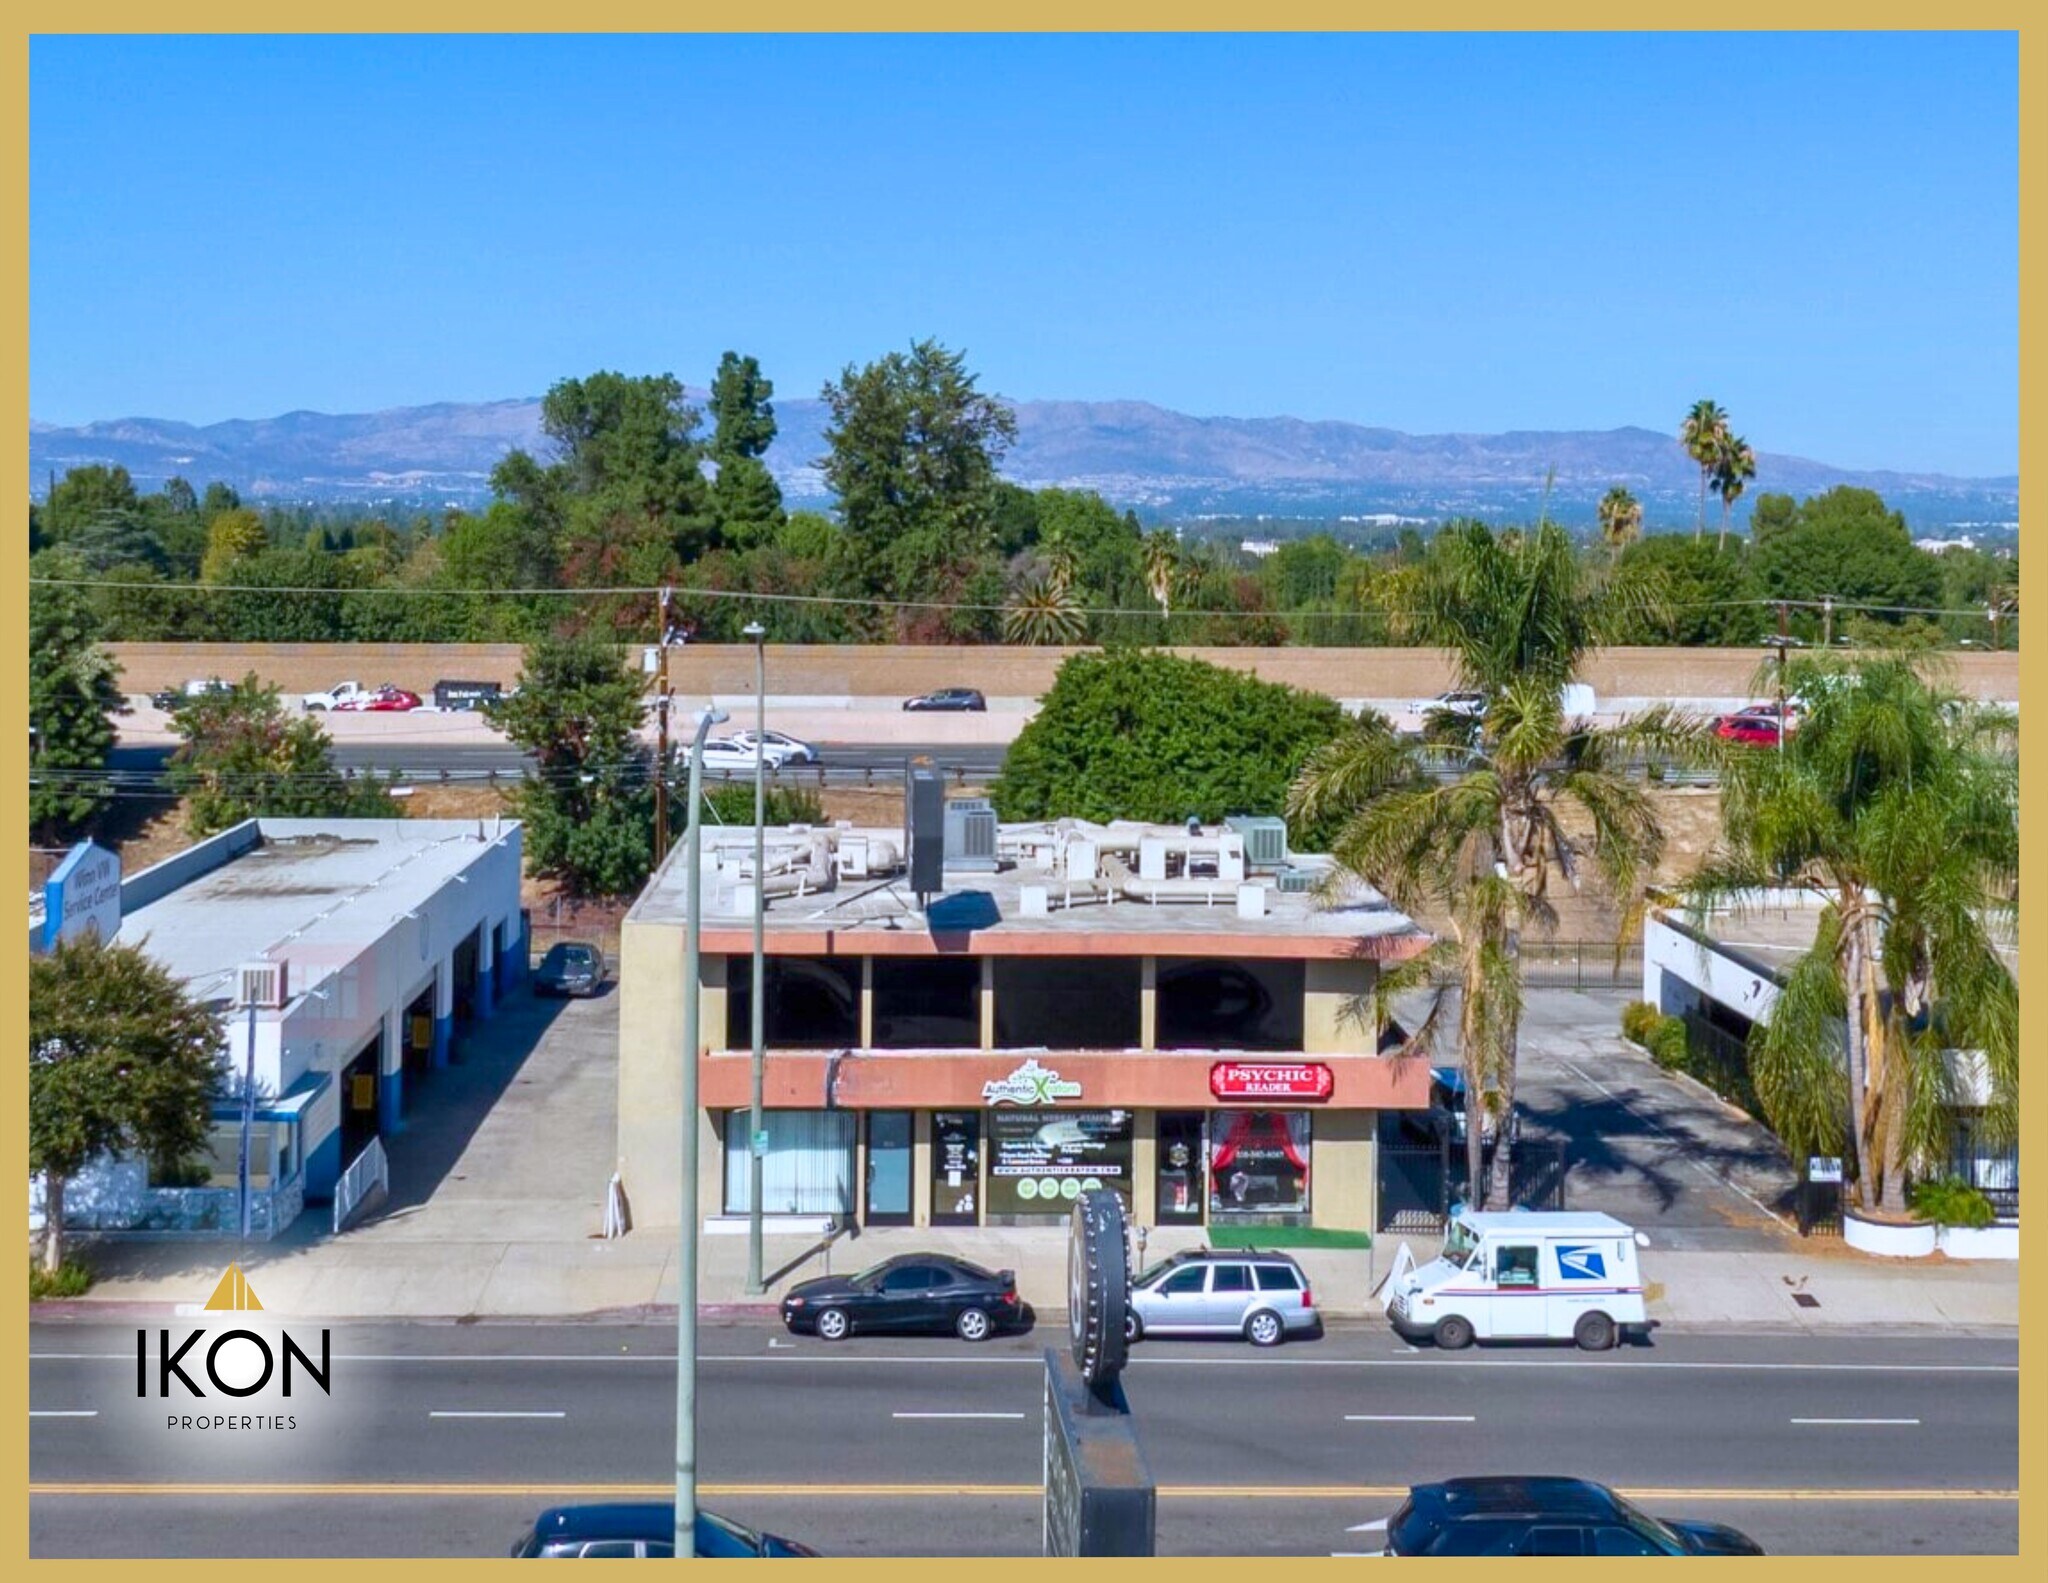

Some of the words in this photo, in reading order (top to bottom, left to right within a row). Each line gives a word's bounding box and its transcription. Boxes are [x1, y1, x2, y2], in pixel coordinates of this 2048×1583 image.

[64, 893, 93, 920] Service
[95, 883, 119, 906] Center
[1227, 1069, 1313, 1082] PSYCHIC
[986, 1083, 1035, 1095] Authentic
[1245, 1083, 1292, 1093] READER
[996, 1114, 1039, 1122] NATURAL
